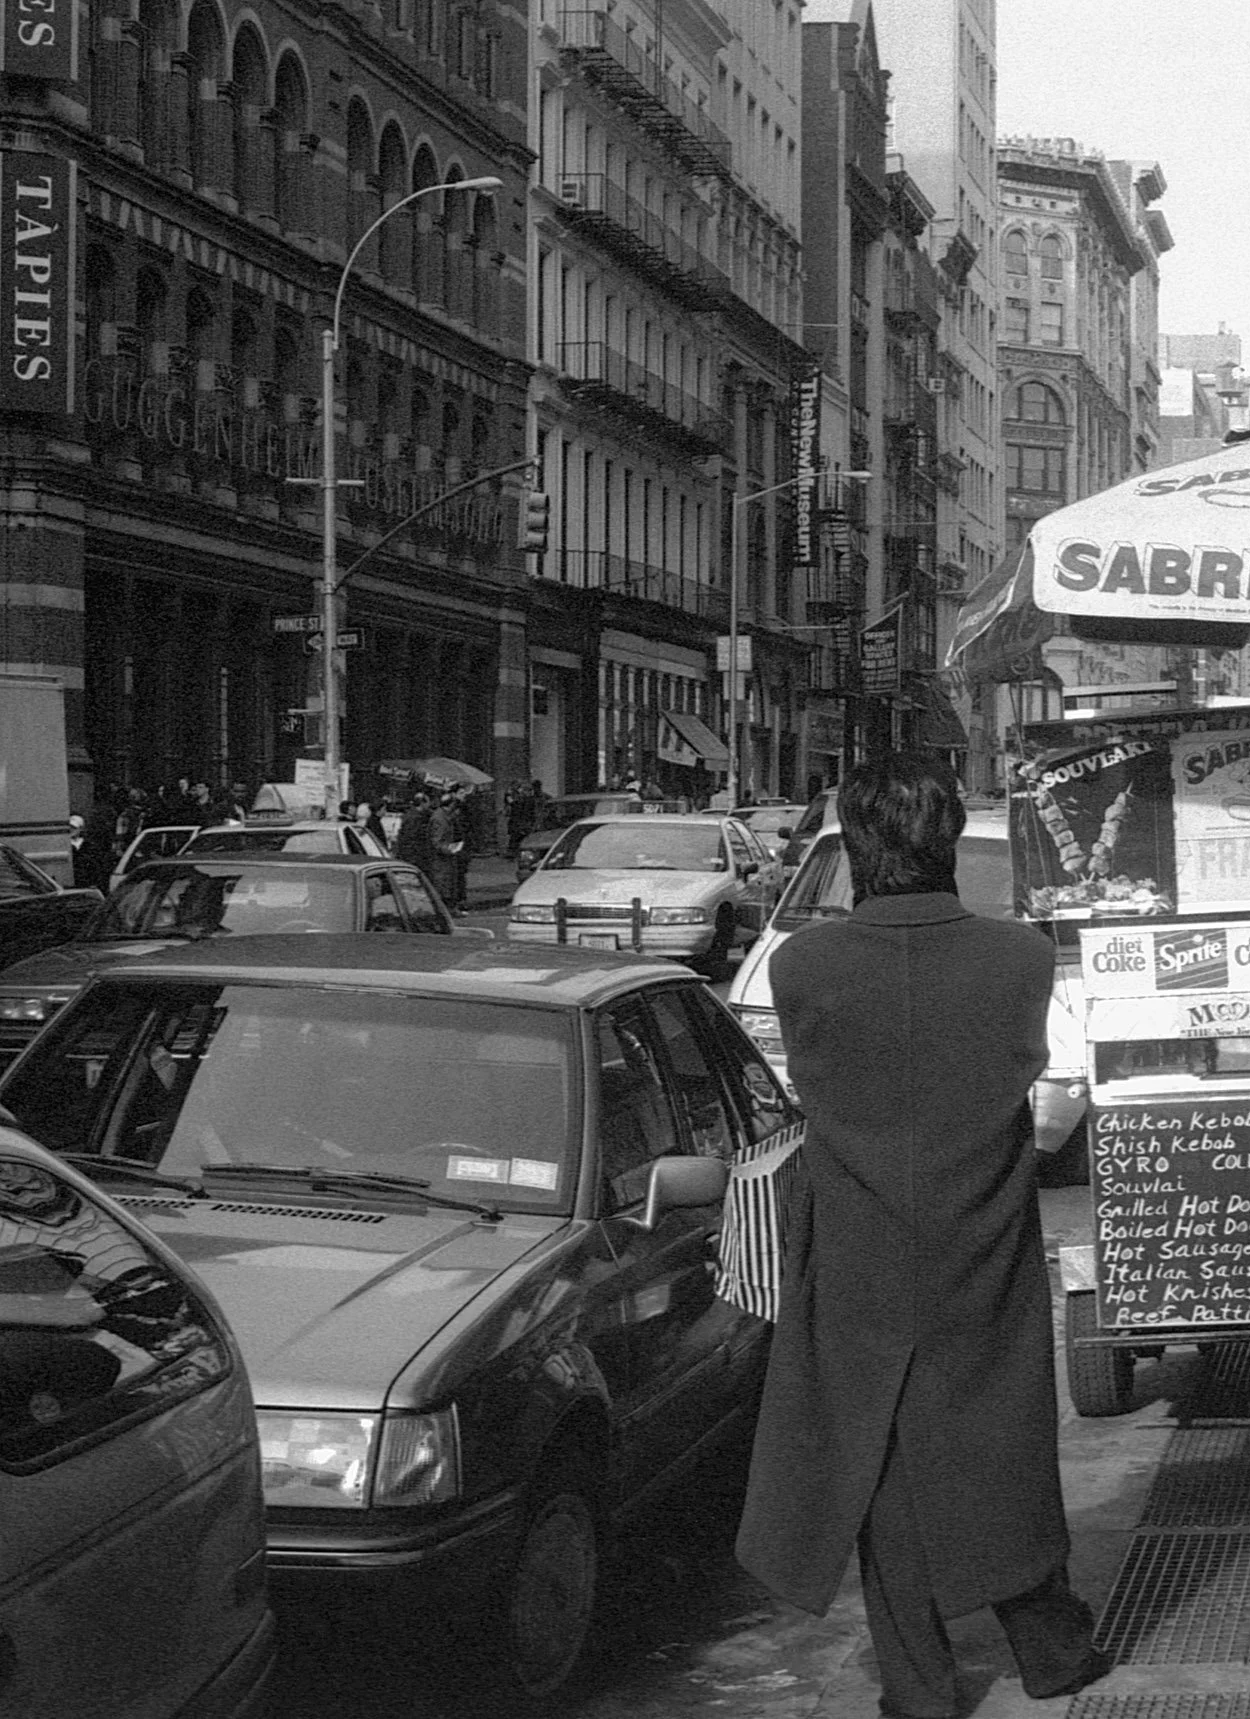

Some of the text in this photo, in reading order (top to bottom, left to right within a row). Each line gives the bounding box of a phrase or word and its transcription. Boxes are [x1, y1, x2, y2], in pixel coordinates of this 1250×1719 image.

[1041, 741, 1152, 788] SOUVLAKI
[1106, 937, 1143, 956] diet
[1158, 934, 1222, 973] Sprite
[1092, 951, 1146, 973] Coke
[1096, 1114, 1181, 1133] Chicken
[1095, 1136, 1161, 1156] Shish
[1097, 1157, 1170, 1176] GYRO
[1097, 1200, 1168, 1219] Grilled
[1179, 1197, 1218, 1217] Hot
[1100, 1221, 1168, 1241] Boiled
[1174, 1219, 1216, 1238] Hot
[1103, 1243, 1145, 1262] Hot
[1103, 1264, 1192, 1284] Italian
[1105, 1285, 1149, 1304] Hot
[1115, 1305, 1176, 1325] Beef
